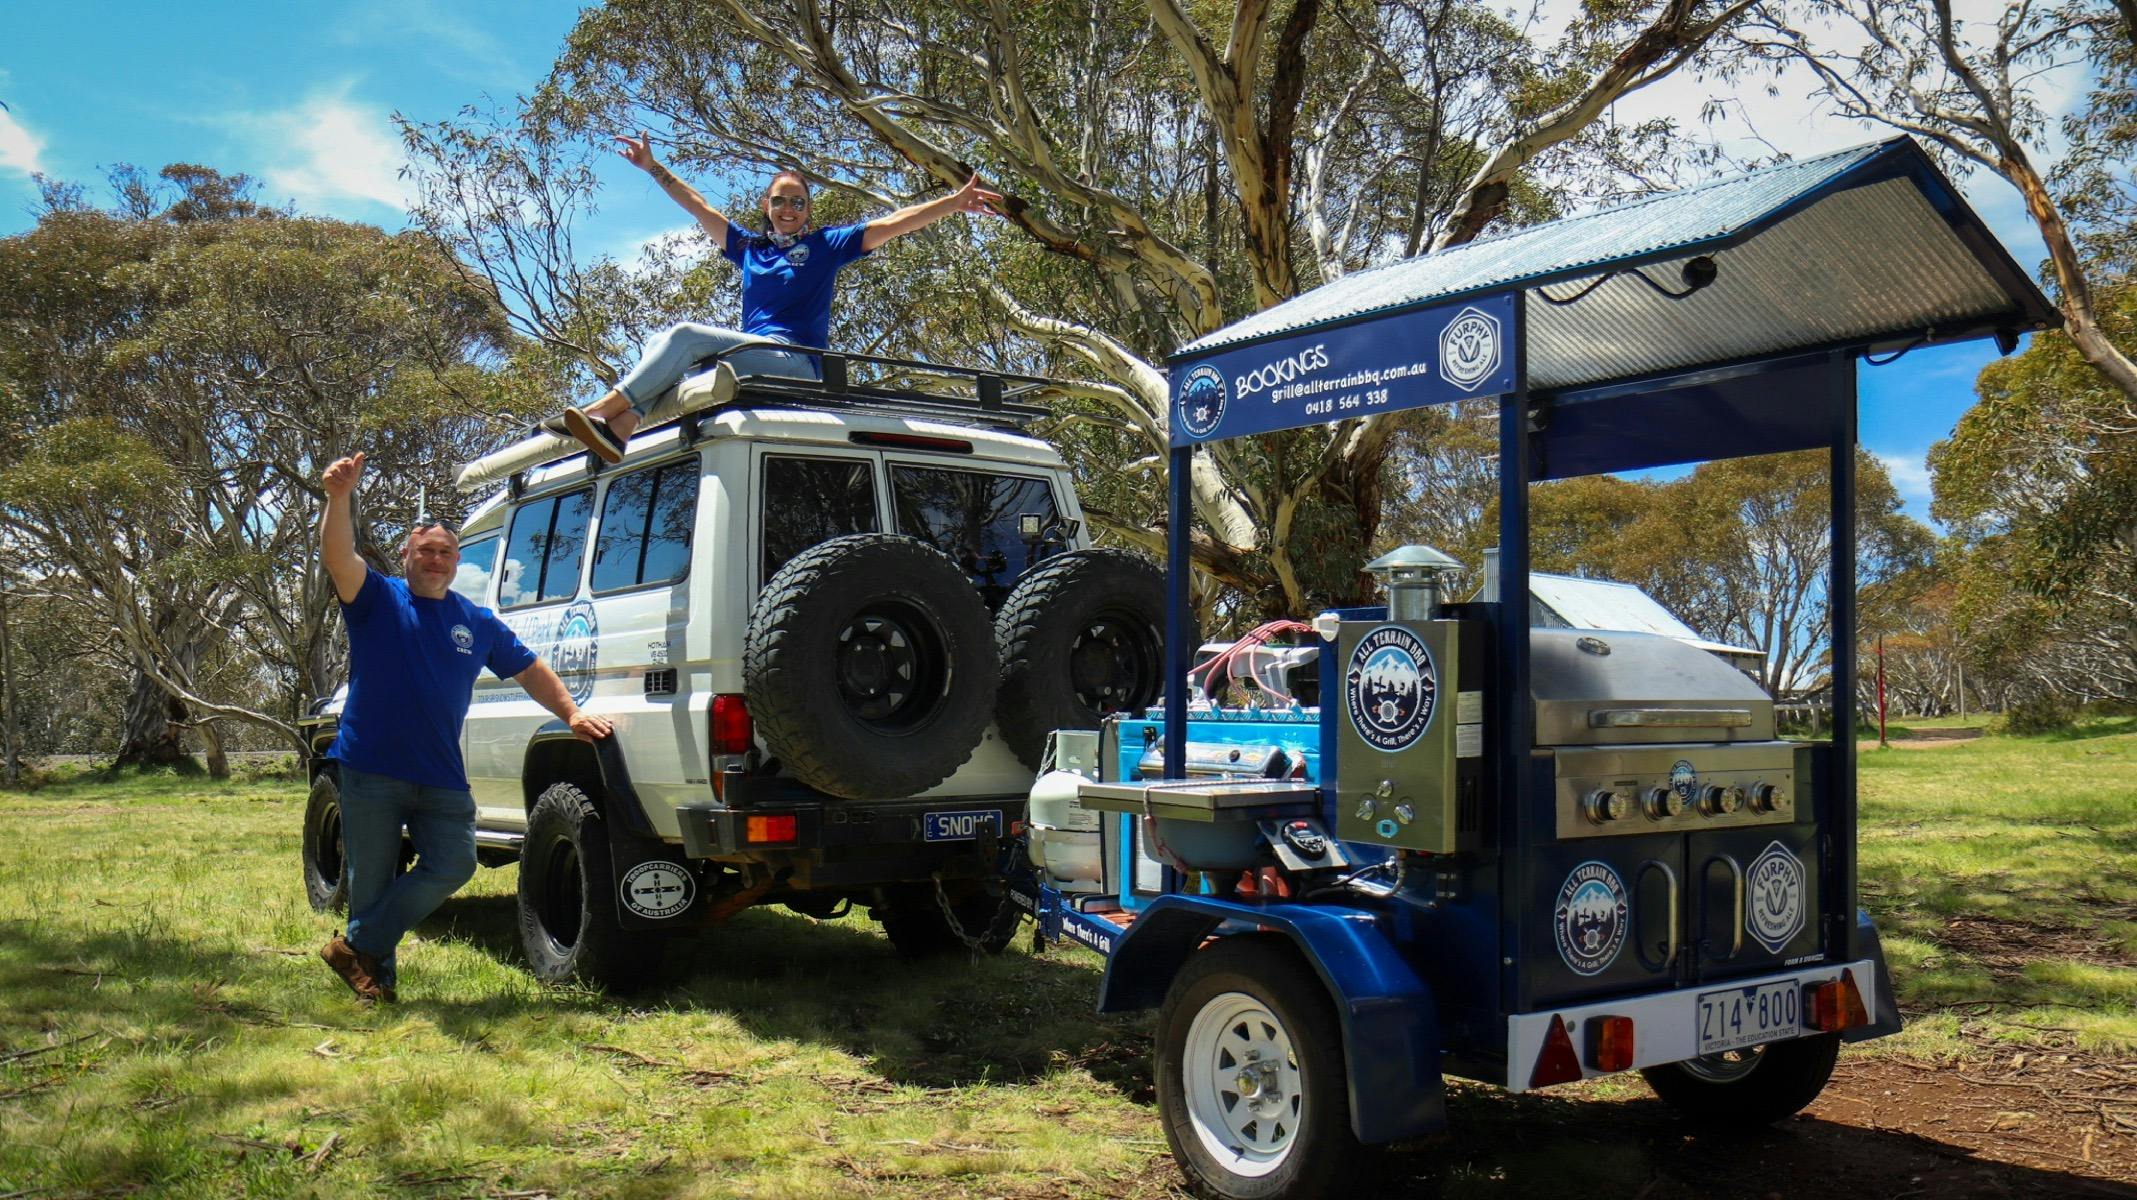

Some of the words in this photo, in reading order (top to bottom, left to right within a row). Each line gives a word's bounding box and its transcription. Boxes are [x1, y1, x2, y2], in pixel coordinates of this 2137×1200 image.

[1450, 321, 1489, 345] FURPHY
[1272, 363, 1427, 403] grill@allterrainbbq.com.au
[1305, 399, 1333, 415] 0418
[1339, 395, 1360, 410] 564
[1366, 389, 1388, 405] 338
[1357, 641, 1374, 663] ALL
[1372, 630, 1412, 650] TERRAIN
[1409, 642, 1427, 667] BBQ
[1350, 687, 1359, 716] Where
[627, 863, 688, 883] TROOPCARRIERS
[1757, 861, 1796, 890] FURPHY
[1564, 879, 1579, 897] ALL
[631, 902, 643, 911] OF
[642, 898, 688, 916] AUSTRALIA
[1785, 906, 1795, 923] ALE
[1093, 932, 1098, 946] A
[1702, 998, 1742, 1040] Z14
[1759, 988, 1796, 1030] 800
[1747, 1029, 1778, 1041] EDUCATION
[1778, 1026, 1795, 1037] STATE
